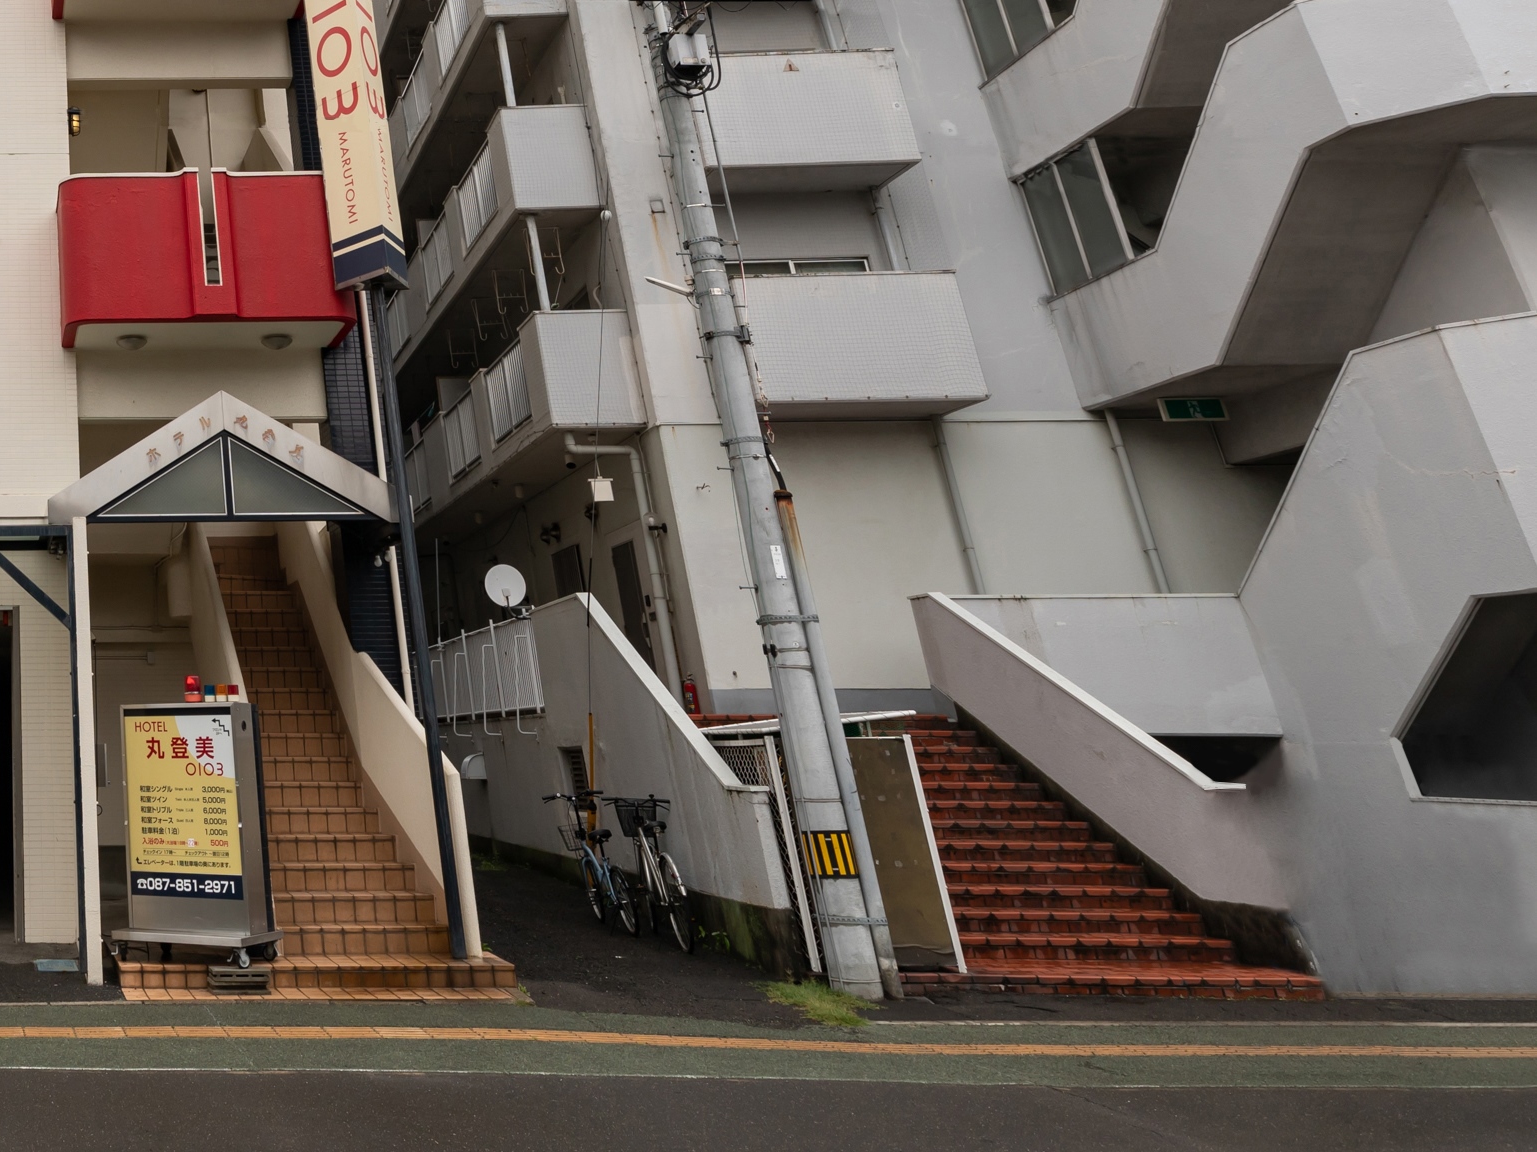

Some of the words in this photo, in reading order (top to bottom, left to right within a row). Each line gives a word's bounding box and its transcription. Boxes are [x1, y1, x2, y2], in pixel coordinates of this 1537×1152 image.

[337, 131, 360, 225] MARUTOMI
[376, 126, 393, 223] MARUTOMI
[146, 416, 211, 463] ホテル
[134, 721, 168, 733] HOTEL
[146, 736, 215, 759] 丸登美
[139, 785, 173, 793] 和室シングル
[201, 786, 225, 794] 3,000円
[202, 796, 226, 804] 5,000円
[140, 806, 172, 814] 和室トリプル
[203, 807, 226, 815] 6,000円
[141, 816, 174, 824] 和室フォース
[204, 818, 227, 826] 8,000円
[205, 828, 228, 836] 1,000円
[210, 839, 229, 847] 500円
[146, 878, 235, 894] 087-851-2971
